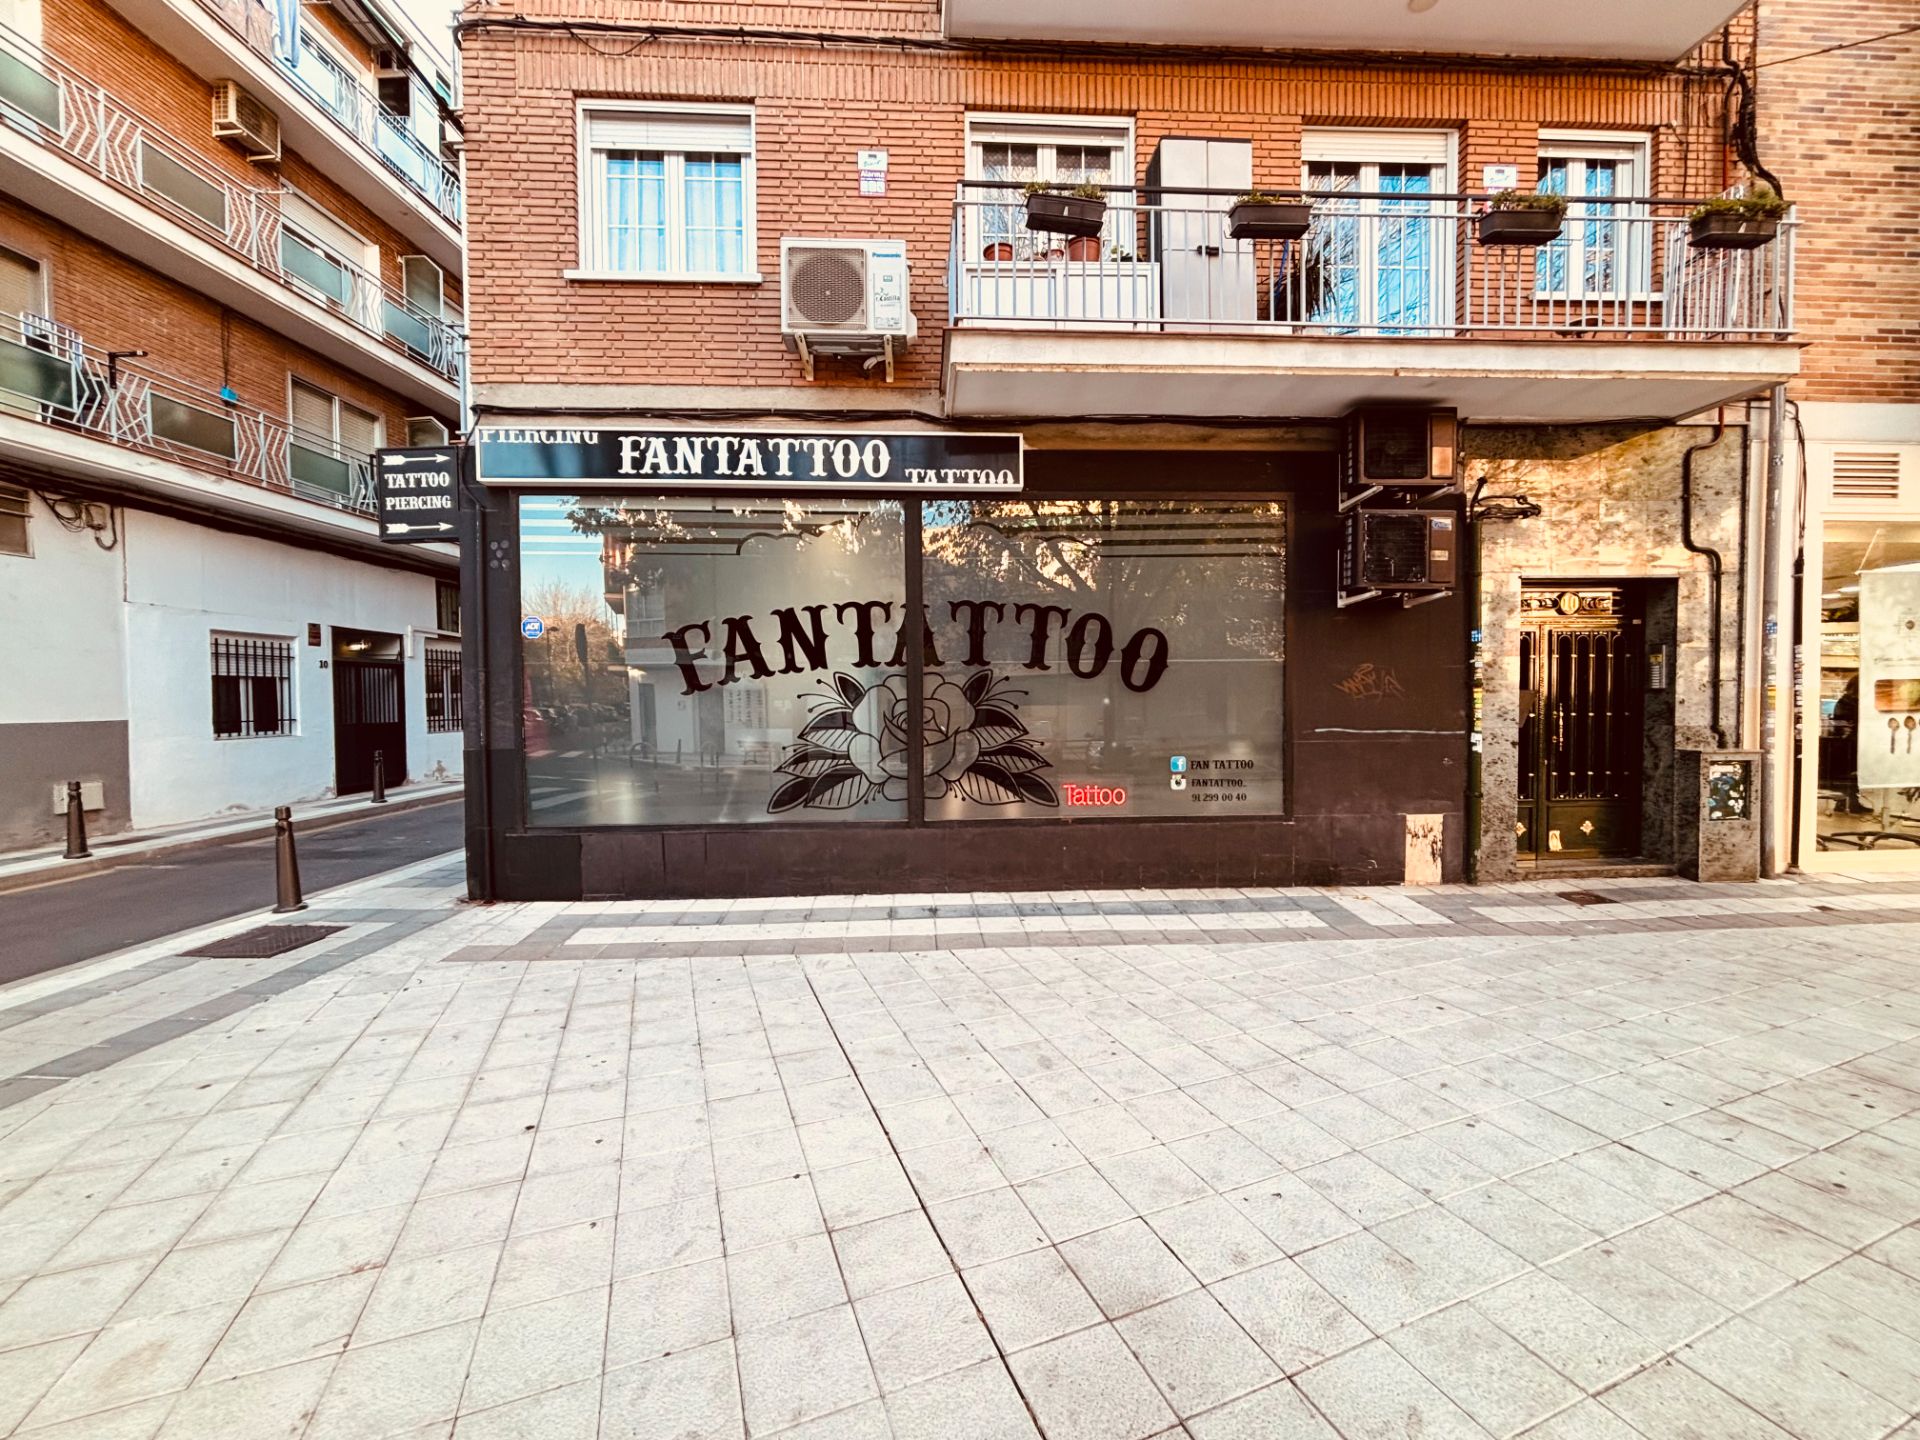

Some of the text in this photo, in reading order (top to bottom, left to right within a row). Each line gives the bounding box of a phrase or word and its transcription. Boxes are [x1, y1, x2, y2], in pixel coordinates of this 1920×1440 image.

[618, 436, 891, 478] FANTATTOO
[384, 471, 450, 489] TATTOO
[385, 495, 452, 510] PIERCING
[662, 599, 1169, 695] FANTATTOO
[319, 660, 328, 669] 10
[1190, 760, 1254, 770] FAN TATTOO
[1063, 784, 1126, 806] Tattoo
[1192, 792, 1247, 802] 91 299 00 40
